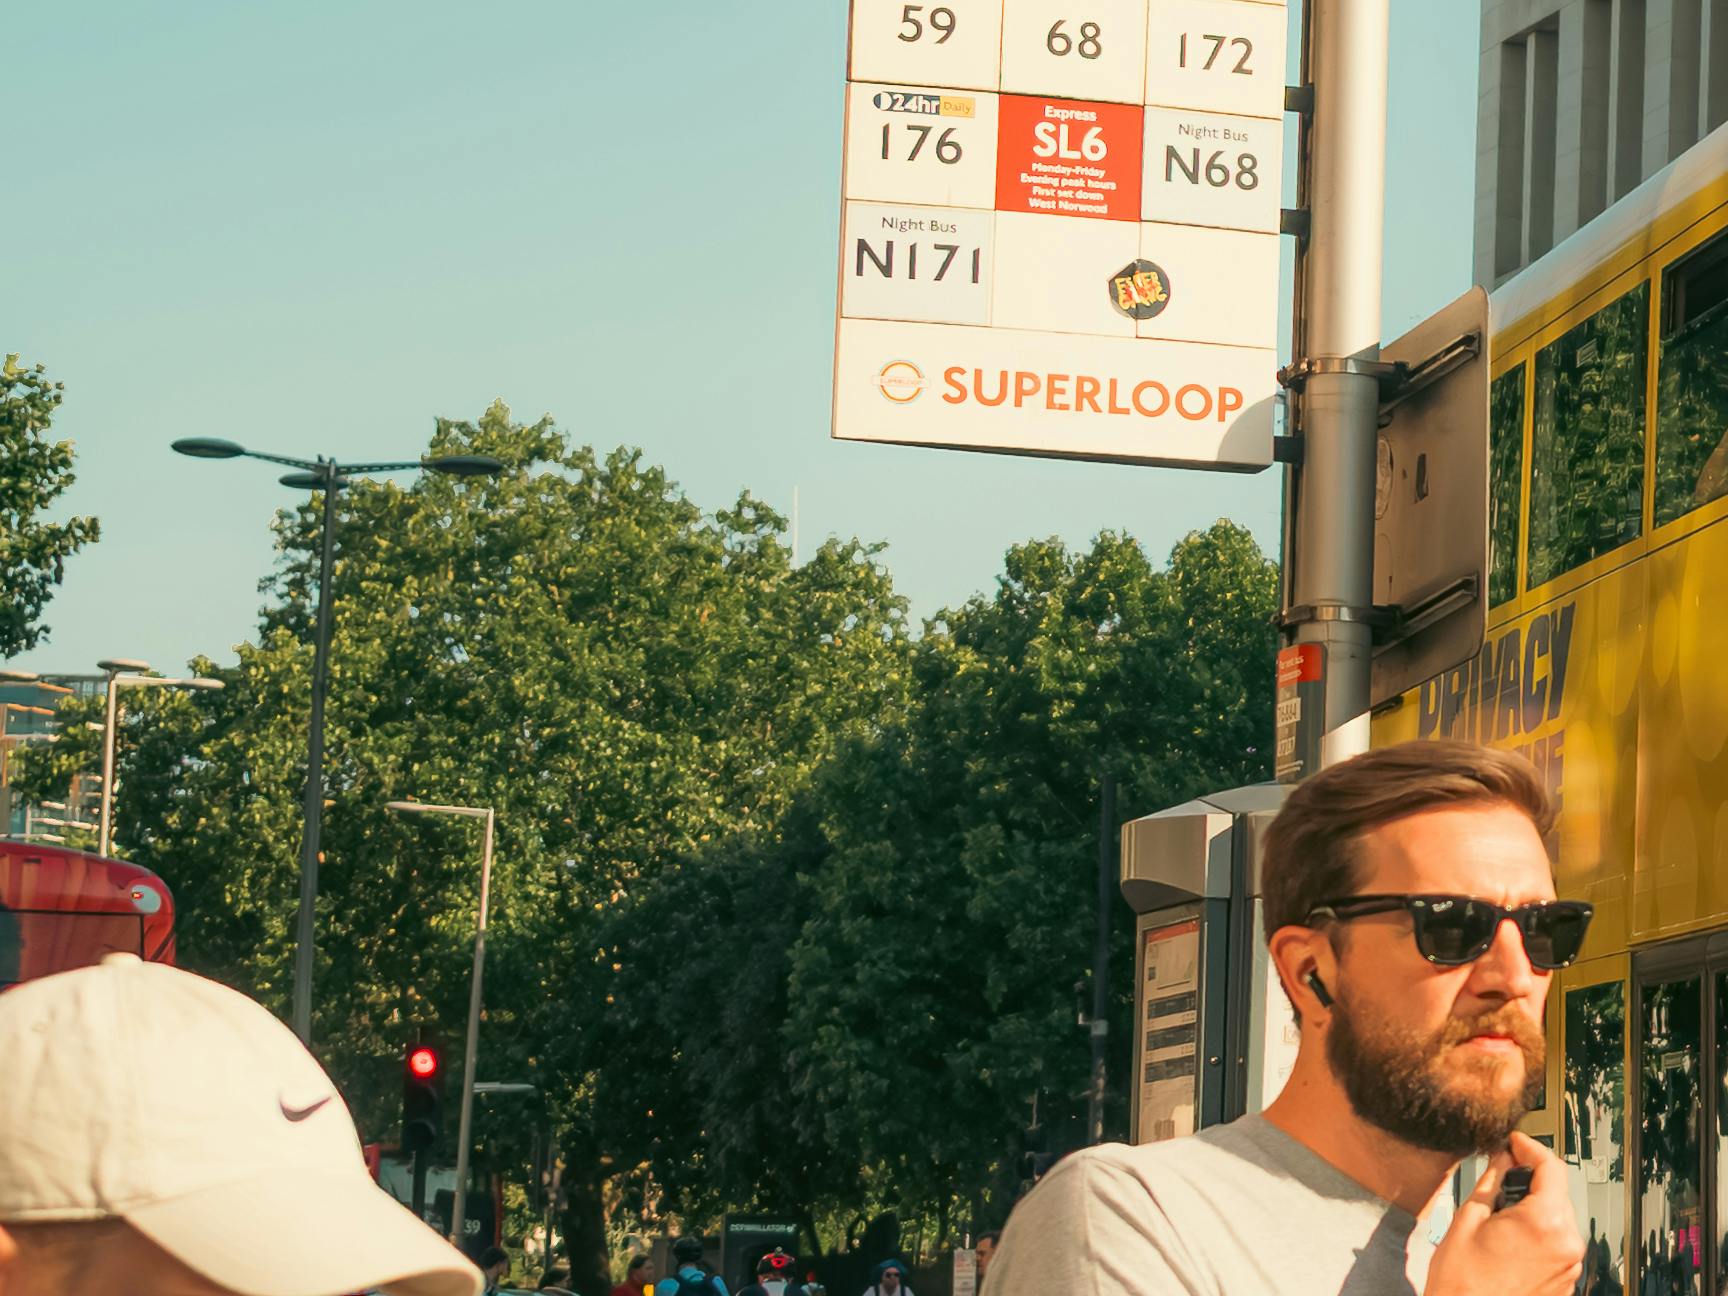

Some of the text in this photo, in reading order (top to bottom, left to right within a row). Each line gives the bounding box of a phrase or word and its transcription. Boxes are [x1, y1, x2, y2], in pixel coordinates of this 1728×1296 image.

[897, 5, 956, 44] 59
[1046, 19, 1102, 60] 68
[1179, 32, 1254, 75] 172
[893, 94, 972, 114] 24hr Daily
[1044, 105, 1097, 121] Express
[880, 123, 962, 165] 176
[1032, 121, 1107, 162] SL6
[1178, 123, 1248, 143] Night Bus
[1165, 145, 1259, 190] N68
[930, 220, 957, 234] Bus
[856, 238, 980, 284] N171
[942, 366, 1243, 423] SUPERLOOP
